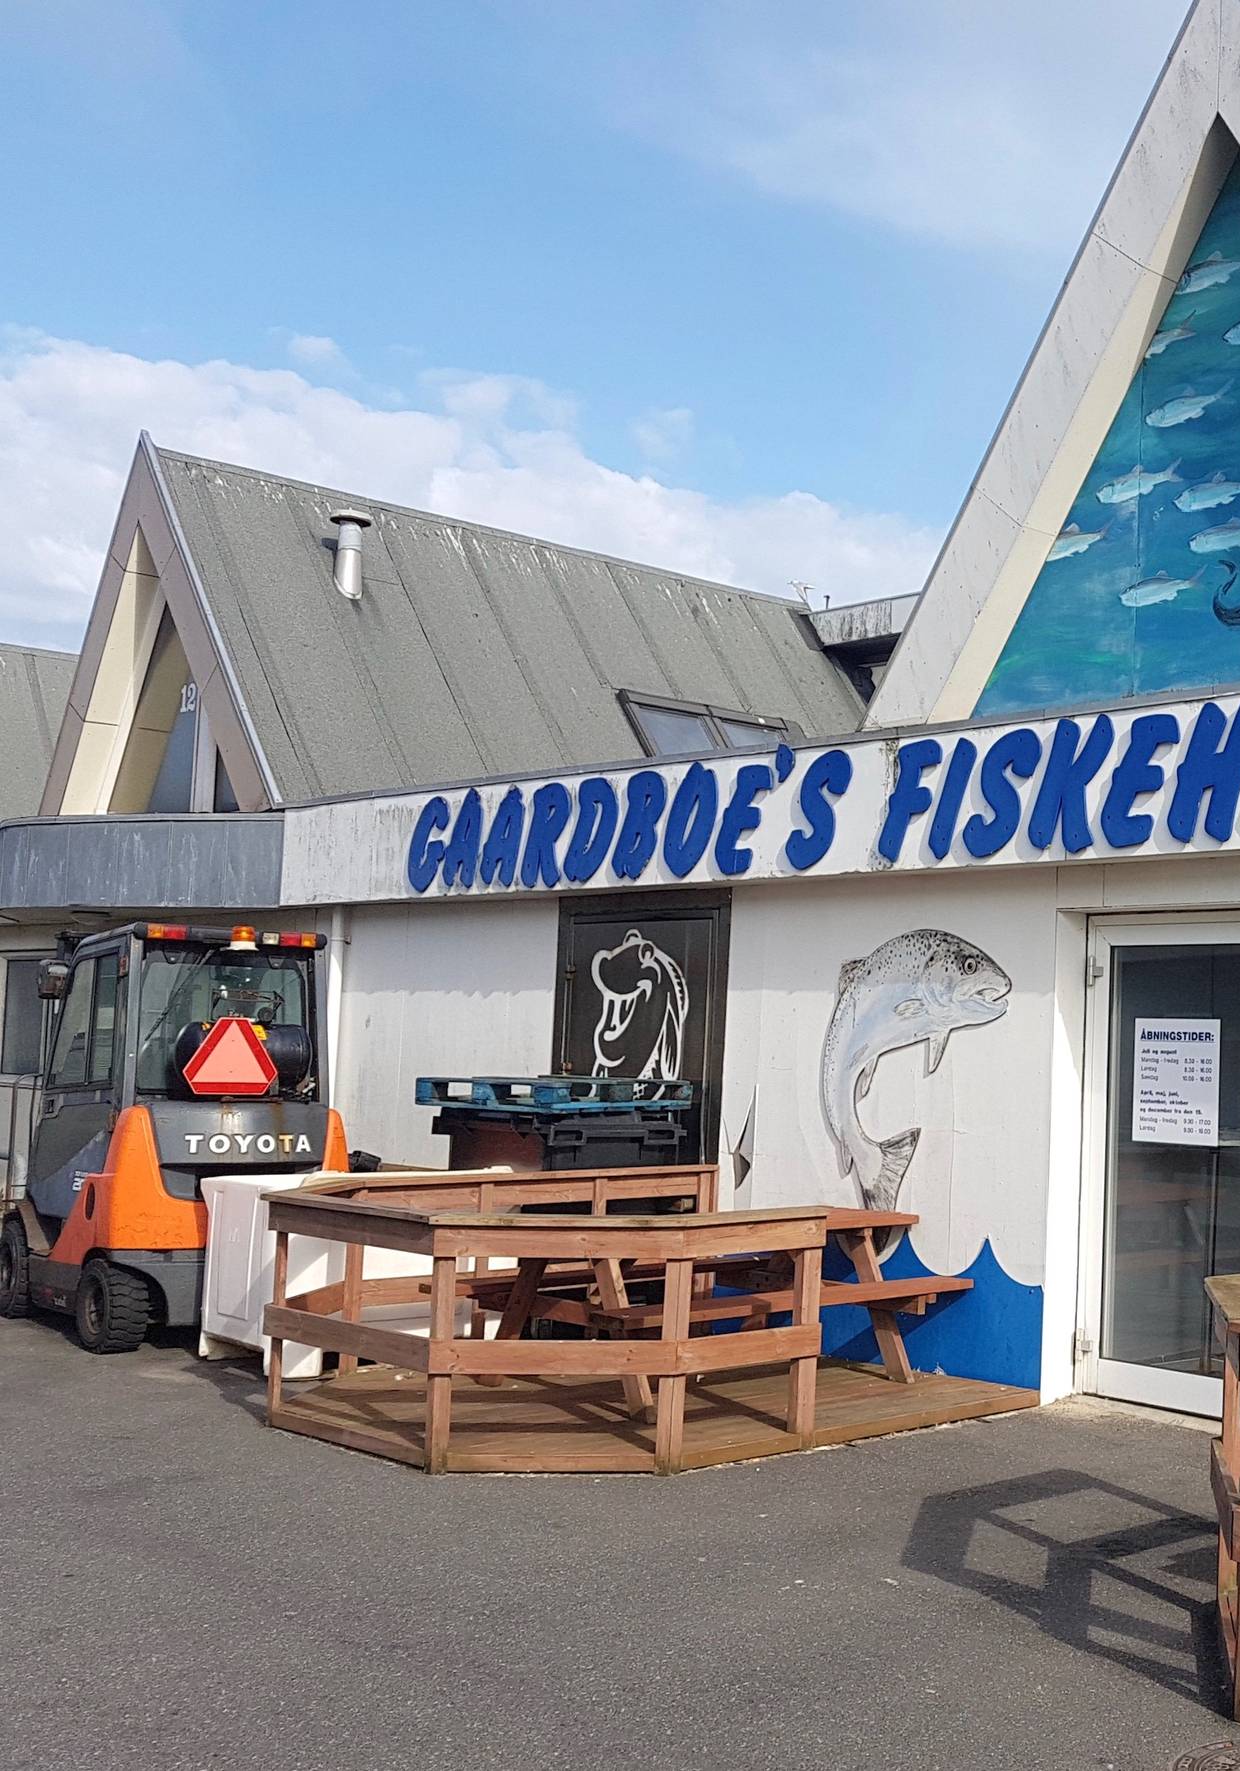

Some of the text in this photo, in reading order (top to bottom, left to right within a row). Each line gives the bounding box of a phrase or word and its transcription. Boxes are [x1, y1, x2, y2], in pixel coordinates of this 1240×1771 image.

[179, 682, 197, 713] 12
[407, 743, 853, 893] GAARDBOE'S
[1140, 1028, 1215, 1041] ÅBNINGSTIDER:
[184, 1134, 312, 1154] TOYOTA
